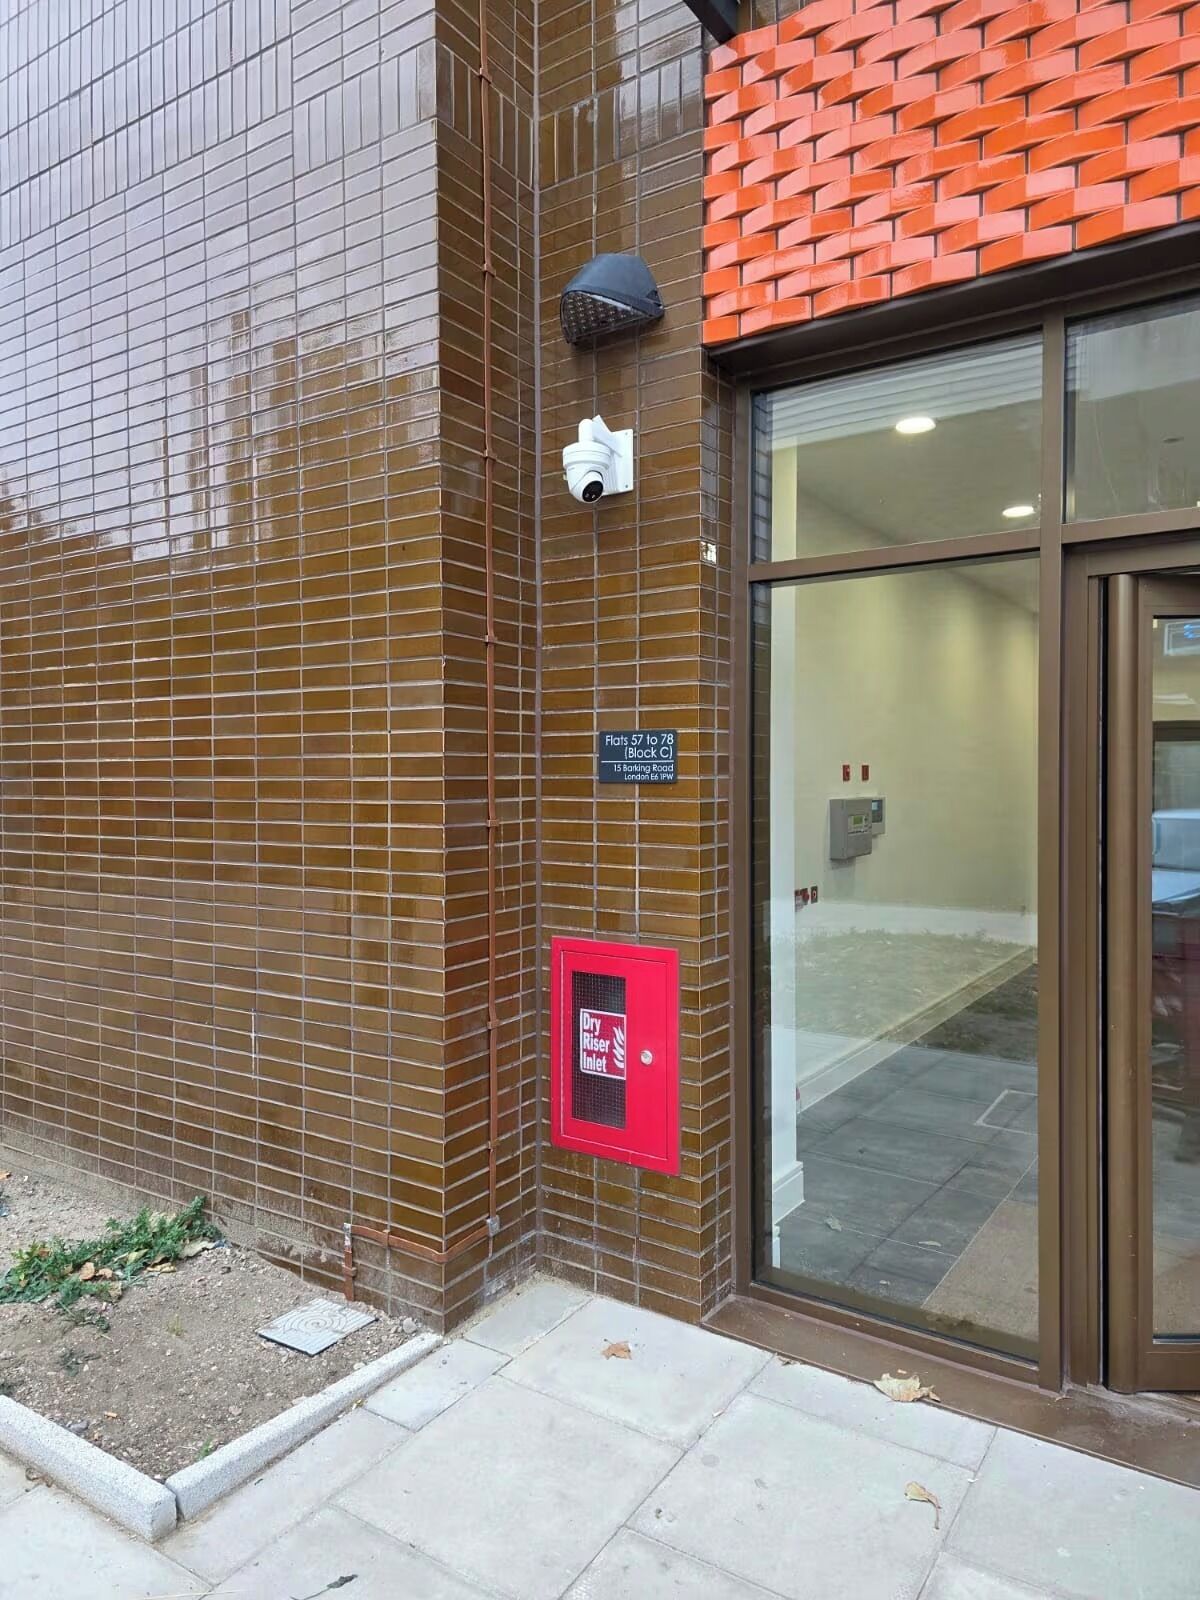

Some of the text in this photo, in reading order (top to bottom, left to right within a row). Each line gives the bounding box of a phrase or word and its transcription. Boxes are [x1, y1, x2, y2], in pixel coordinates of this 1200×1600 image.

[605, 733, 674, 746] Flats 57 to 78
[624, 745, 673, 760] (Block C)
[614, 763, 674, 773] 15 Barking Road
[624, 773, 650, 781] London
[583, 1012, 601, 1036] Dry
[583, 1032, 610, 1053] Riser
[583, 1052, 607, 1072] Inlet
